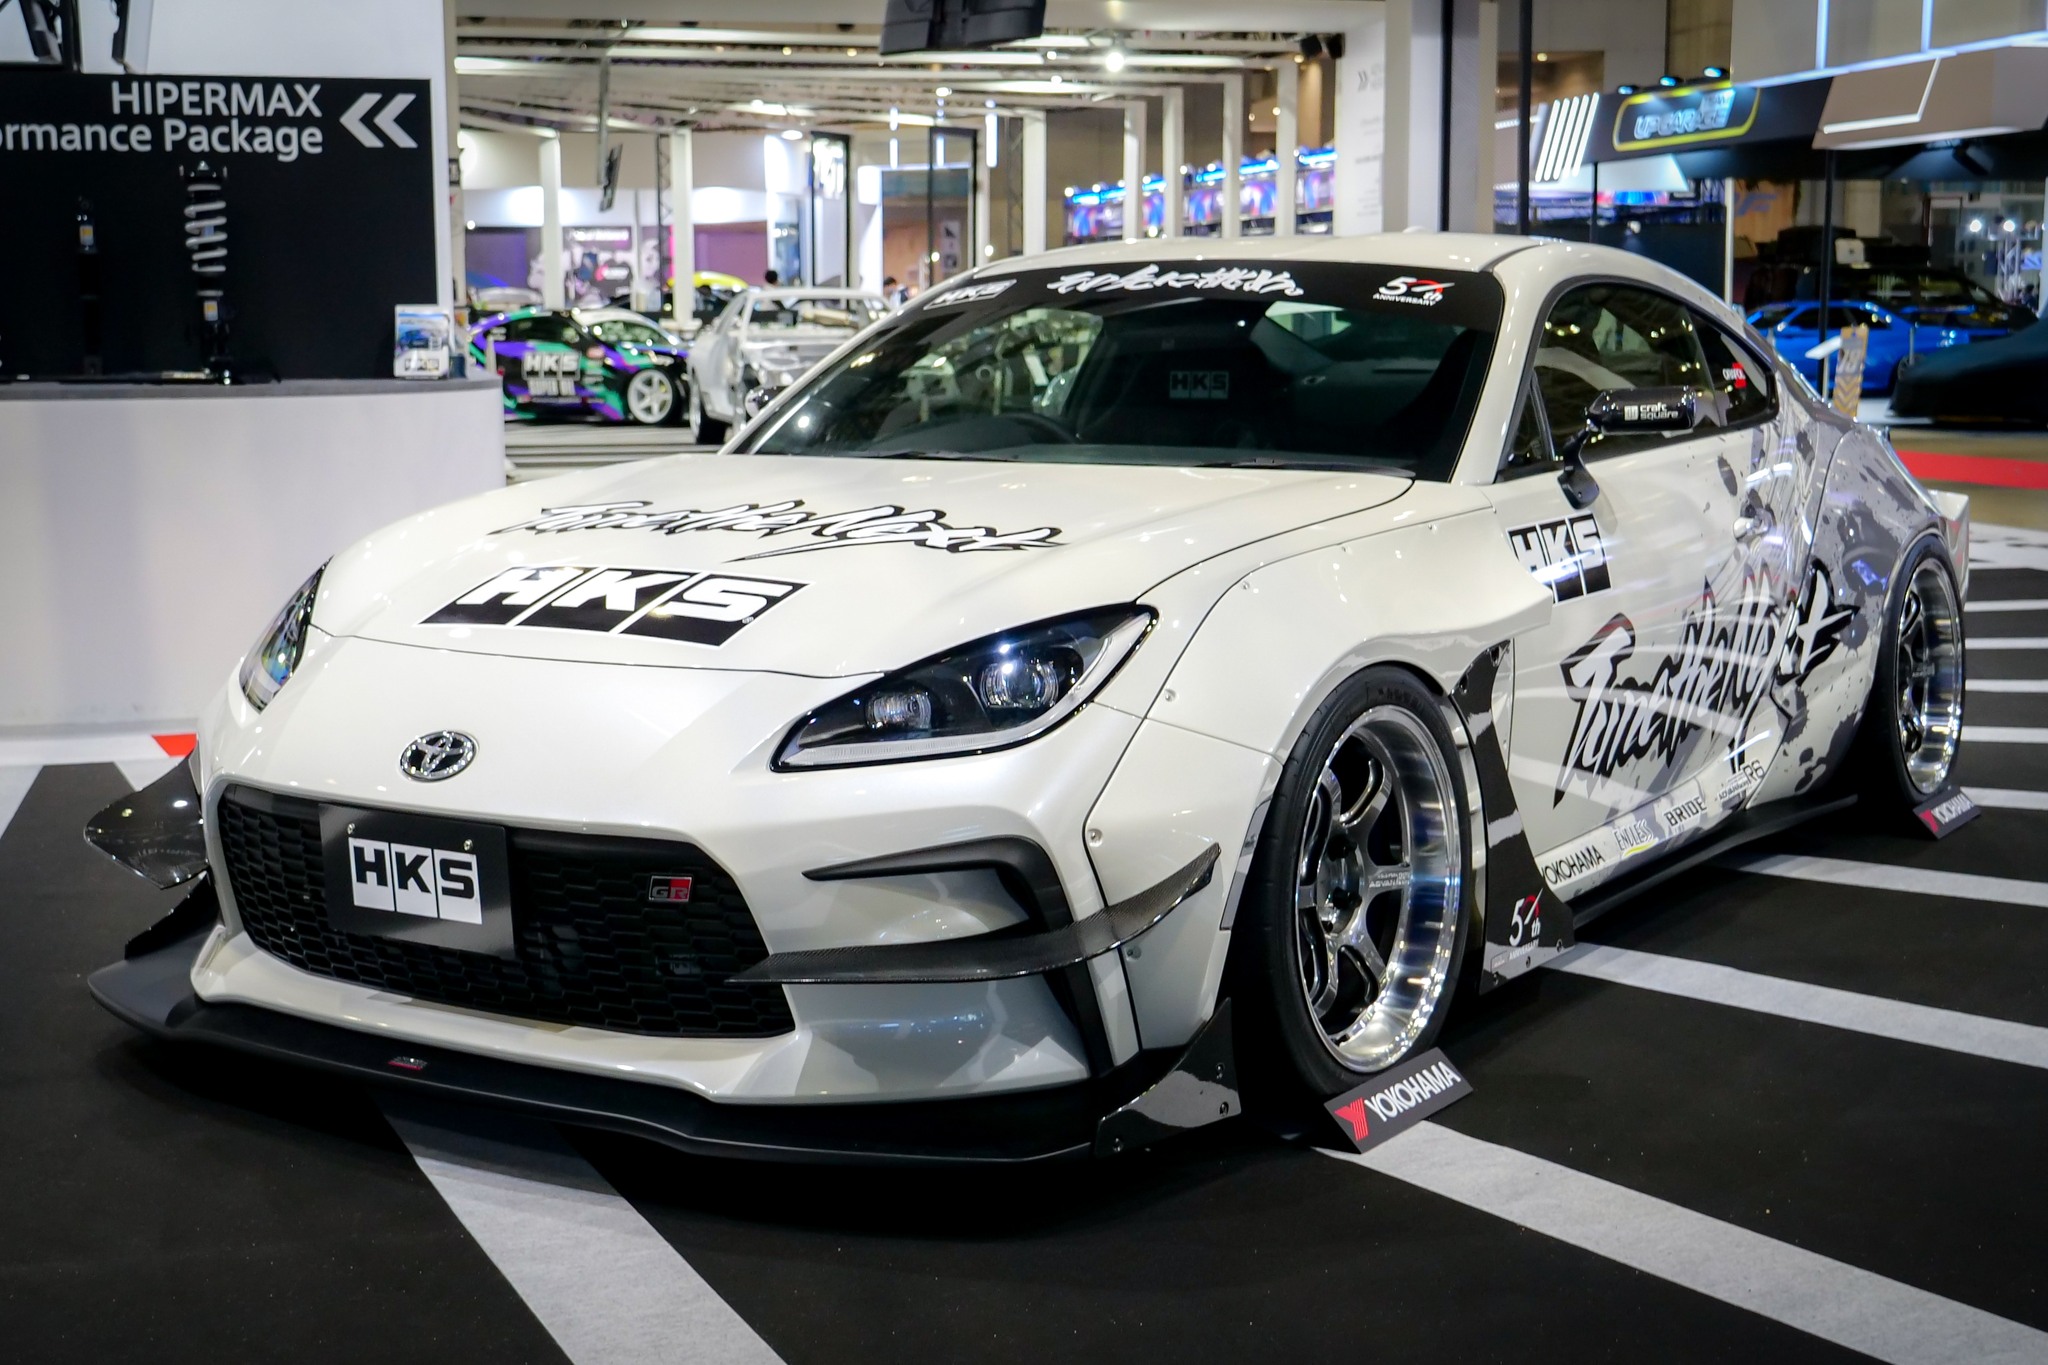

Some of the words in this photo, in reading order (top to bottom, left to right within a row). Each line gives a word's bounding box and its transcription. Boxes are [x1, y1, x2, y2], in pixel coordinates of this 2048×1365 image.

[110, 81, 323, 117] HIPERMAX
[163, 118, 323, 162] Package
[1372, 292, 1437, 307] ANNIVERSARY
[523, 352, 580, 373] HKS
[1170, 372, 1228, 391] HKS
[1640, 402, 1668, 413] craft
[1640, 410, 1679, 421] square
[1663, 796, 1708, 827] BRIDE
[1614, 819, 1654, 851] ENDLESS
[352, 844, 477, 900] HKS
[1363, 1060, 1462, 1123] YOKOHAMA
